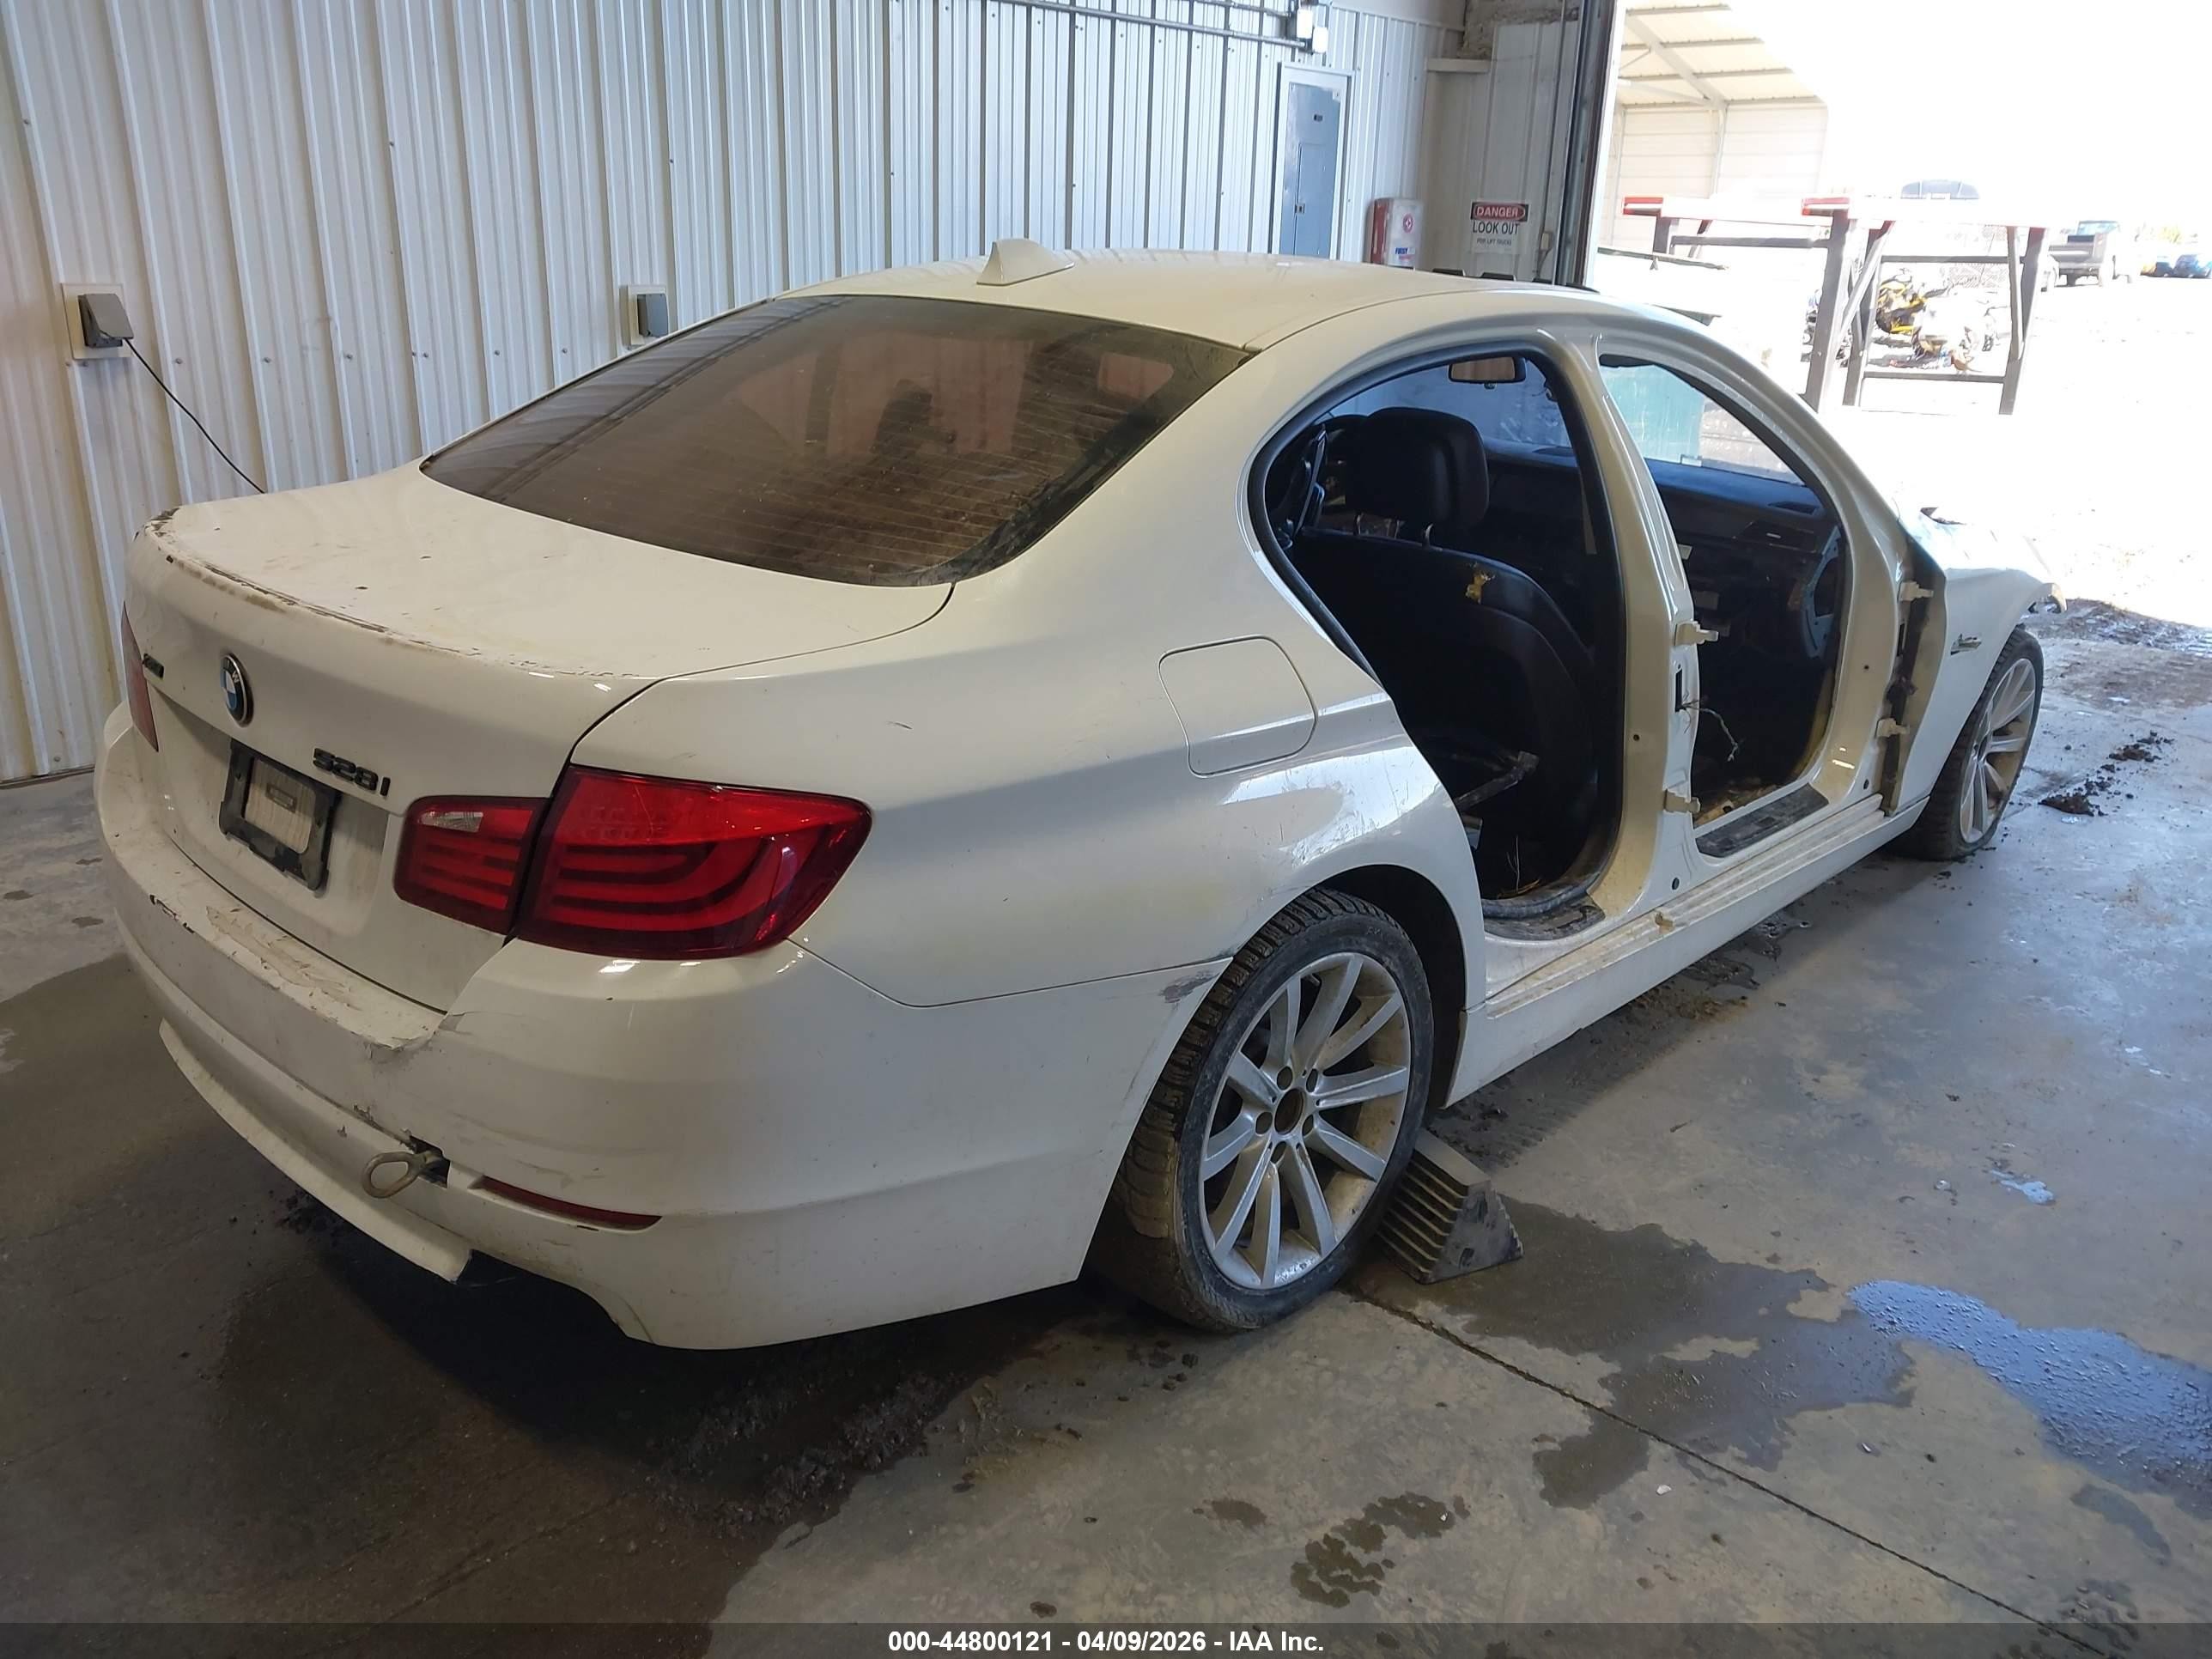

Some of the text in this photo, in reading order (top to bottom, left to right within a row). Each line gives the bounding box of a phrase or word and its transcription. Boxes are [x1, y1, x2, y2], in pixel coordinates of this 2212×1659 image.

[1476, 206, 1519, 218] DANGER
[1473, 222, 1520, 235] LOOK OUT
